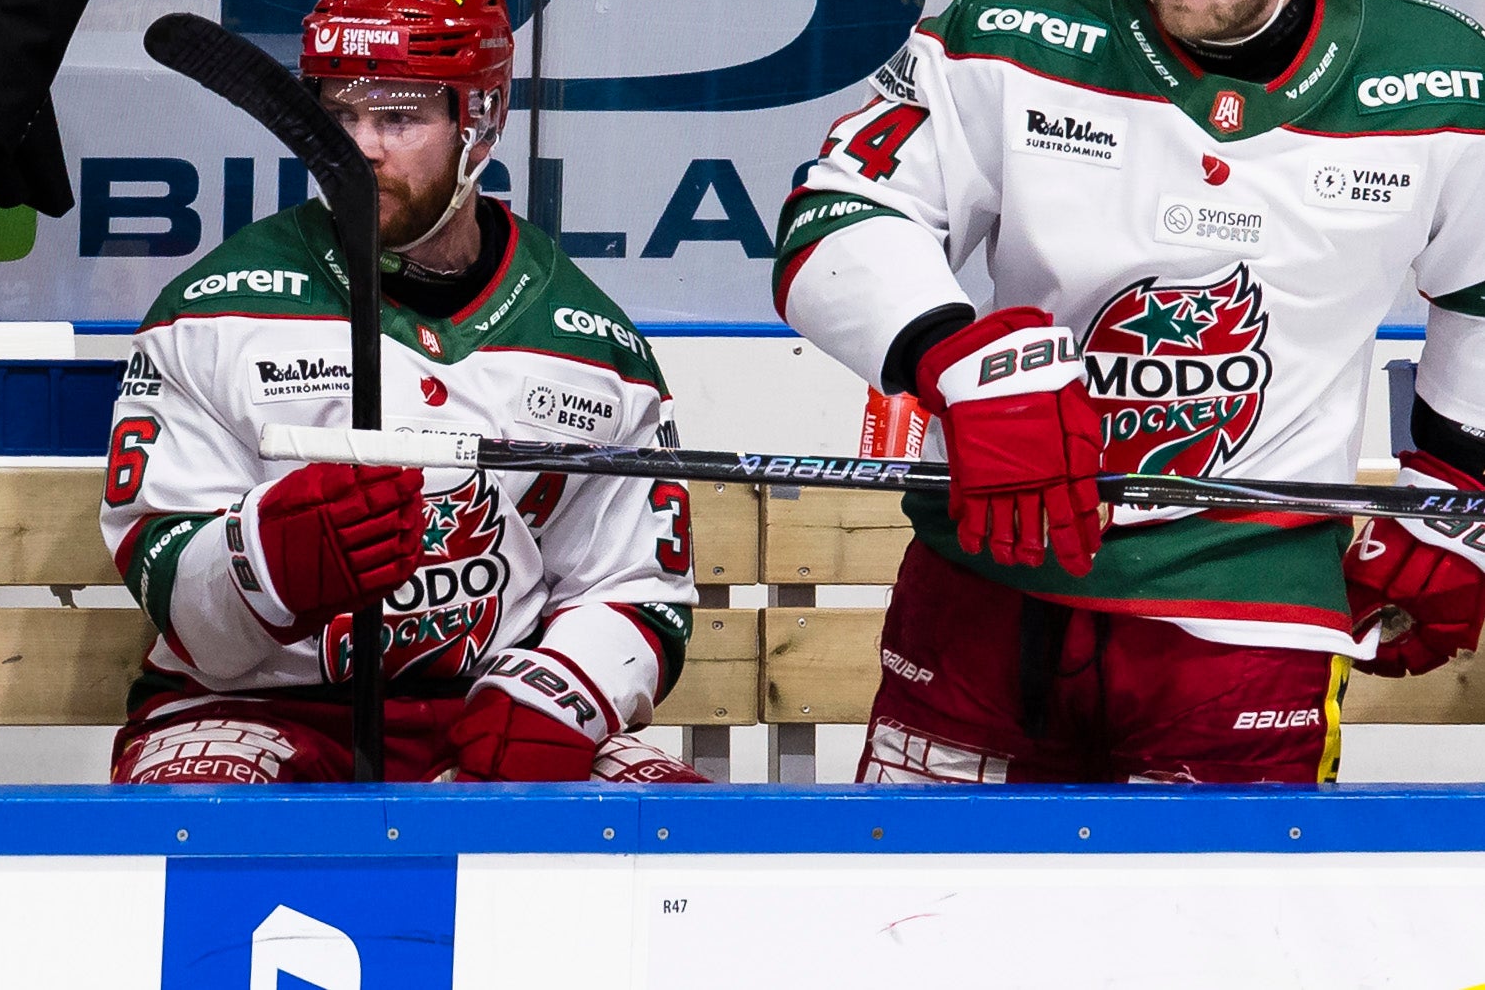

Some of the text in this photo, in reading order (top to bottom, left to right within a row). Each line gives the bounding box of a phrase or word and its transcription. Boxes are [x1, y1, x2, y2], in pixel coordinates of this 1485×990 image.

[342, 28, 400, 46] SVENSKA
[342, 41, 372, 56] SPEL
[1026, 137, 1113, 160] SURSTRÖMMING
[1352, 169, 1412, 188] VIMAB
[1350, 187, 1392, 204] BESS
[1198, 208, 1262, 229] SYNSAM
[1196, 224, 1261, 244] SPORTS
[183, 269, 310, 301] coreIT
[978, 336, 1083, 387] BAU
[1085, 354, 1259, 398] MODO
[263, 382, 351, 397] SURSTRÖMMING
[560, 392, 613, 420] VIMAB
[557, 409, 596, 432] BESS
[861, 412, 877, 458] ERVIT
[904, 410, 924, 458] ERVIT
[383, 557, 499, 613] ODO
[487, 653, 597, 728] UER
[1232, 708, 1321, 730] BAUER
[663, 899, 688, 914] R47
